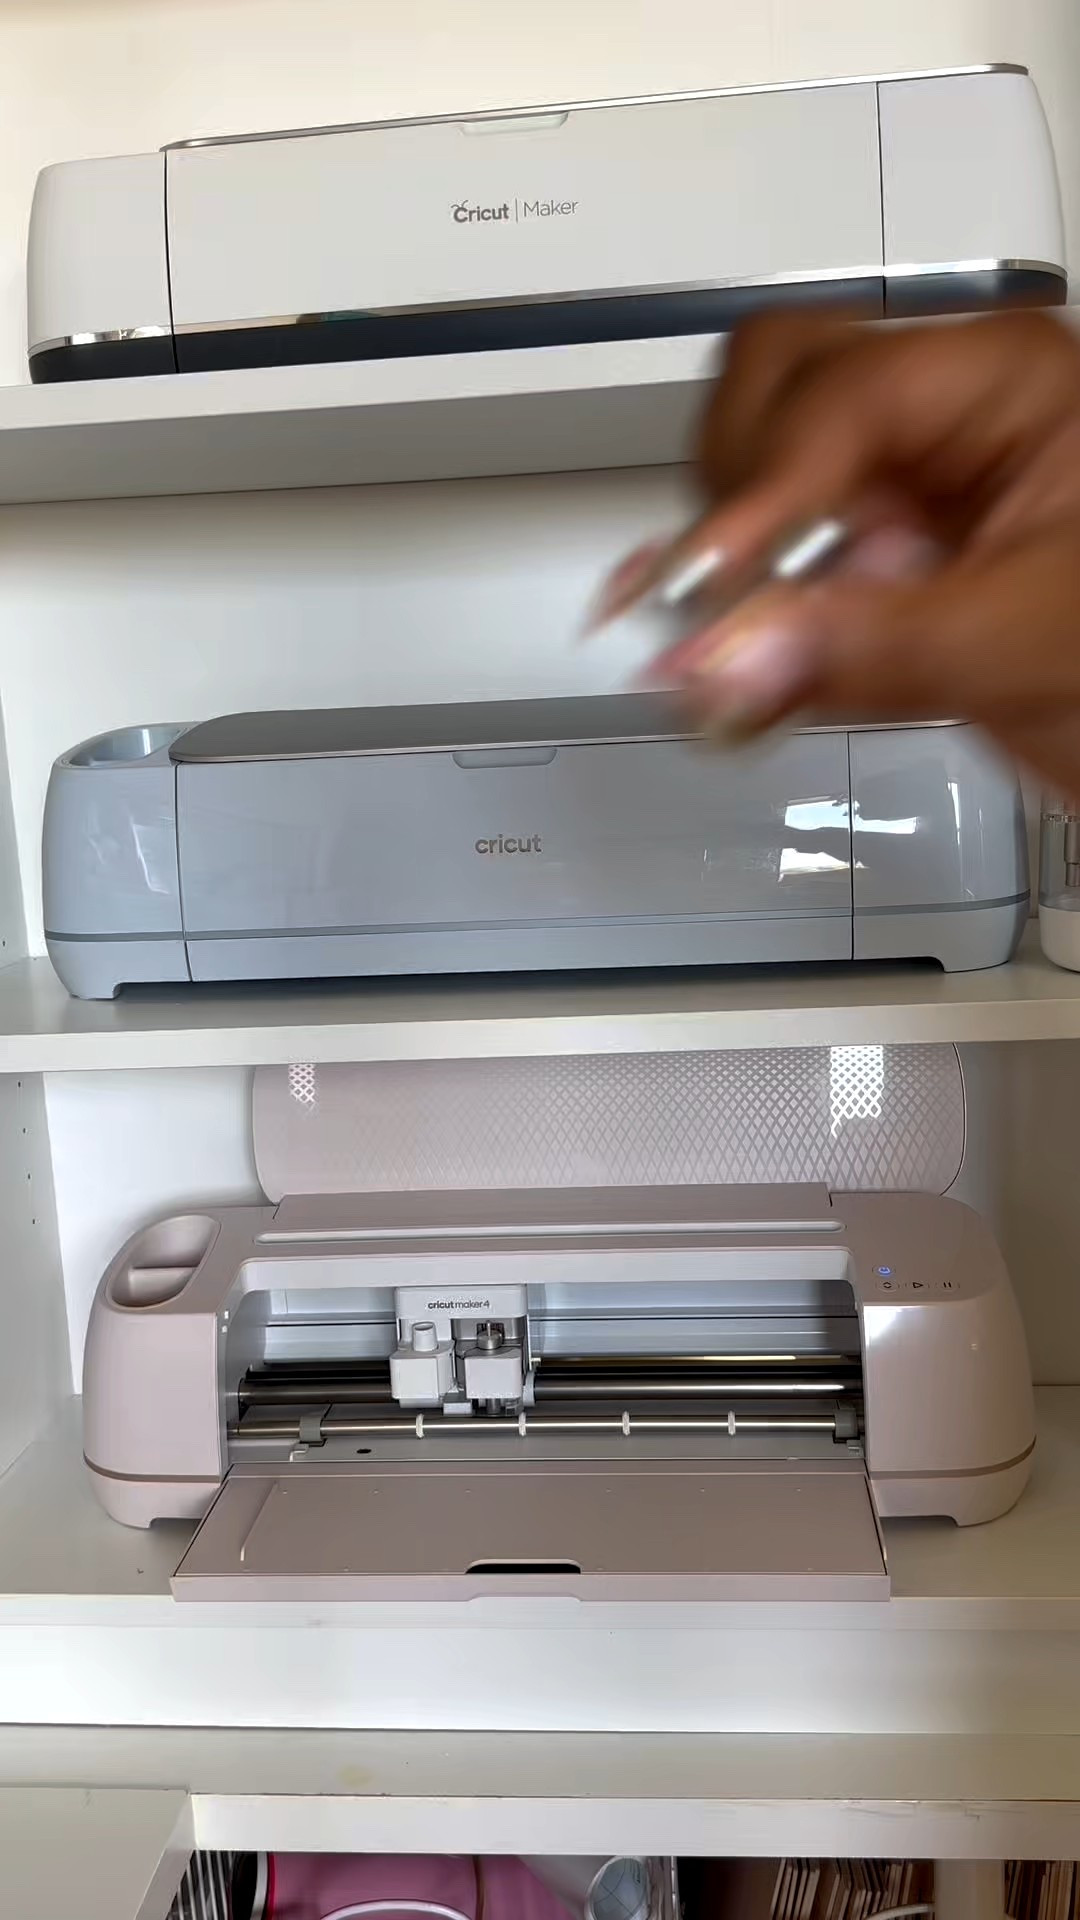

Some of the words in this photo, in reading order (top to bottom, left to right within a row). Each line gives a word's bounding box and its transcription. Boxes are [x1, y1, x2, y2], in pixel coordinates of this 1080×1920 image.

[452, 200, 509, 223] Cricut
[524, 200, 579, 217] Maker
[475, 834, 542, 854] cricut
